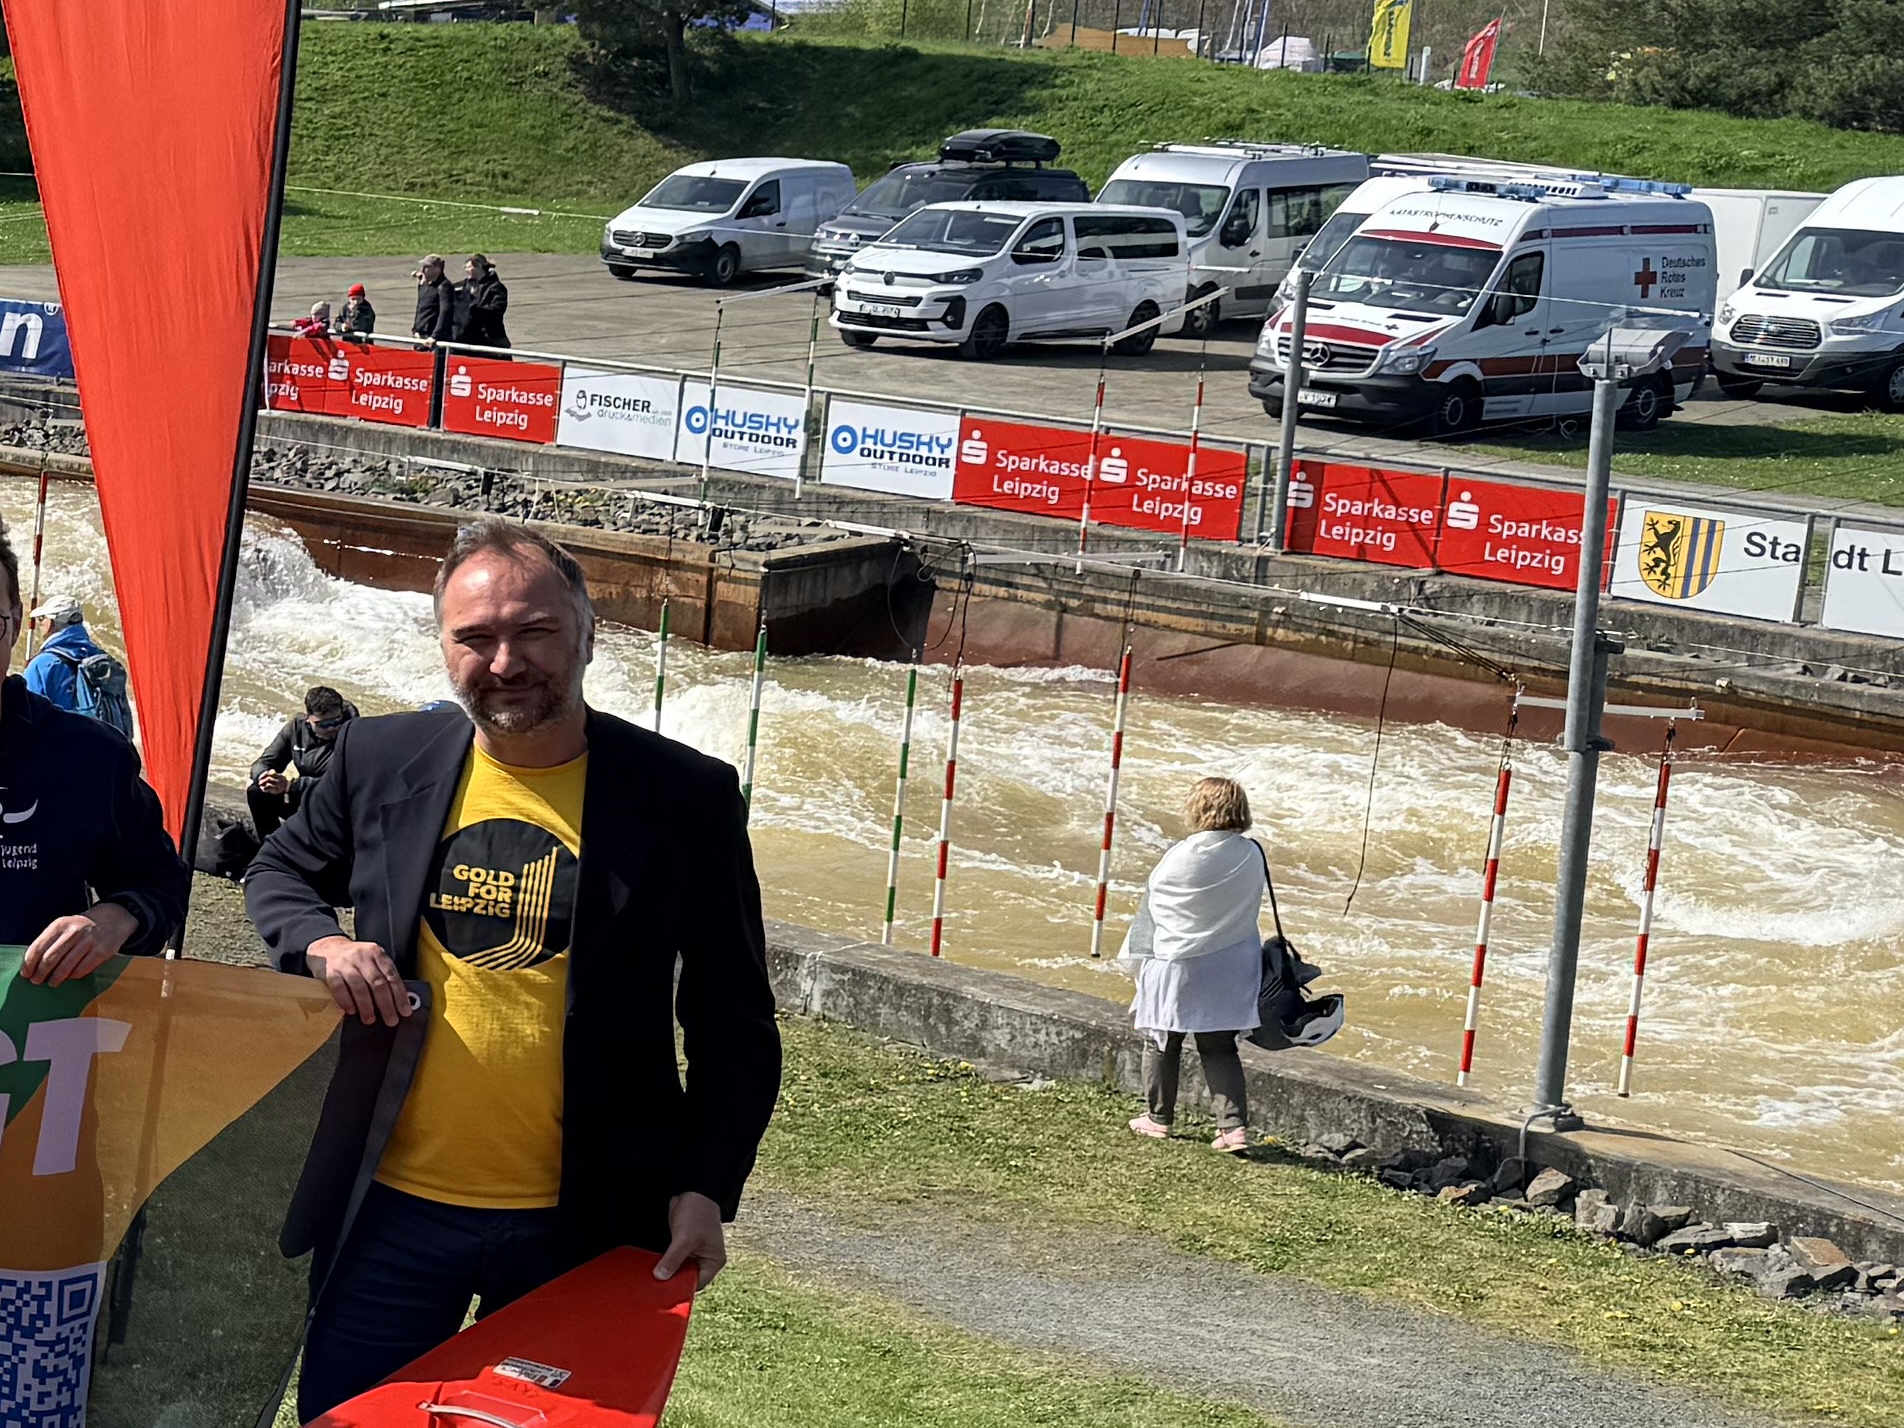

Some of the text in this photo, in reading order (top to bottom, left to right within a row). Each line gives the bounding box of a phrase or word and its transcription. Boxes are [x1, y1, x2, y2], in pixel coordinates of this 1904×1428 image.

[269, 359, 324, 380] arkasse
[354, 367, 429, 394] Sparkasse
[351, 390, 404, 414] Leipzig
[477, 382, 553, 408] Sparkasse
[590, 393, 651, 414] FISCHER
[475, 405, 529, 430] Leipzig
[713, 406, 800, 435] HUSKY
[711, 427, 798, 449] OUTDOOR
[861, 426, 953, 456] HUSKY
[859, 446, 951, 469] OUTDOOR
[995, 449, 1092, 481] Sparkasse
[992, 474, 1060, 505] Leipzig
[1135, 468, 1238, 500] Sparkasse
[1323, 491, 1434, 526] Sparkasse
[1319, 518, 1397, 552] Leipzig
[1482, 542, 1567, 576] Leipzig
[453, 864, 515, 887] GOLD
[468, 882, 513, 903] FOR
